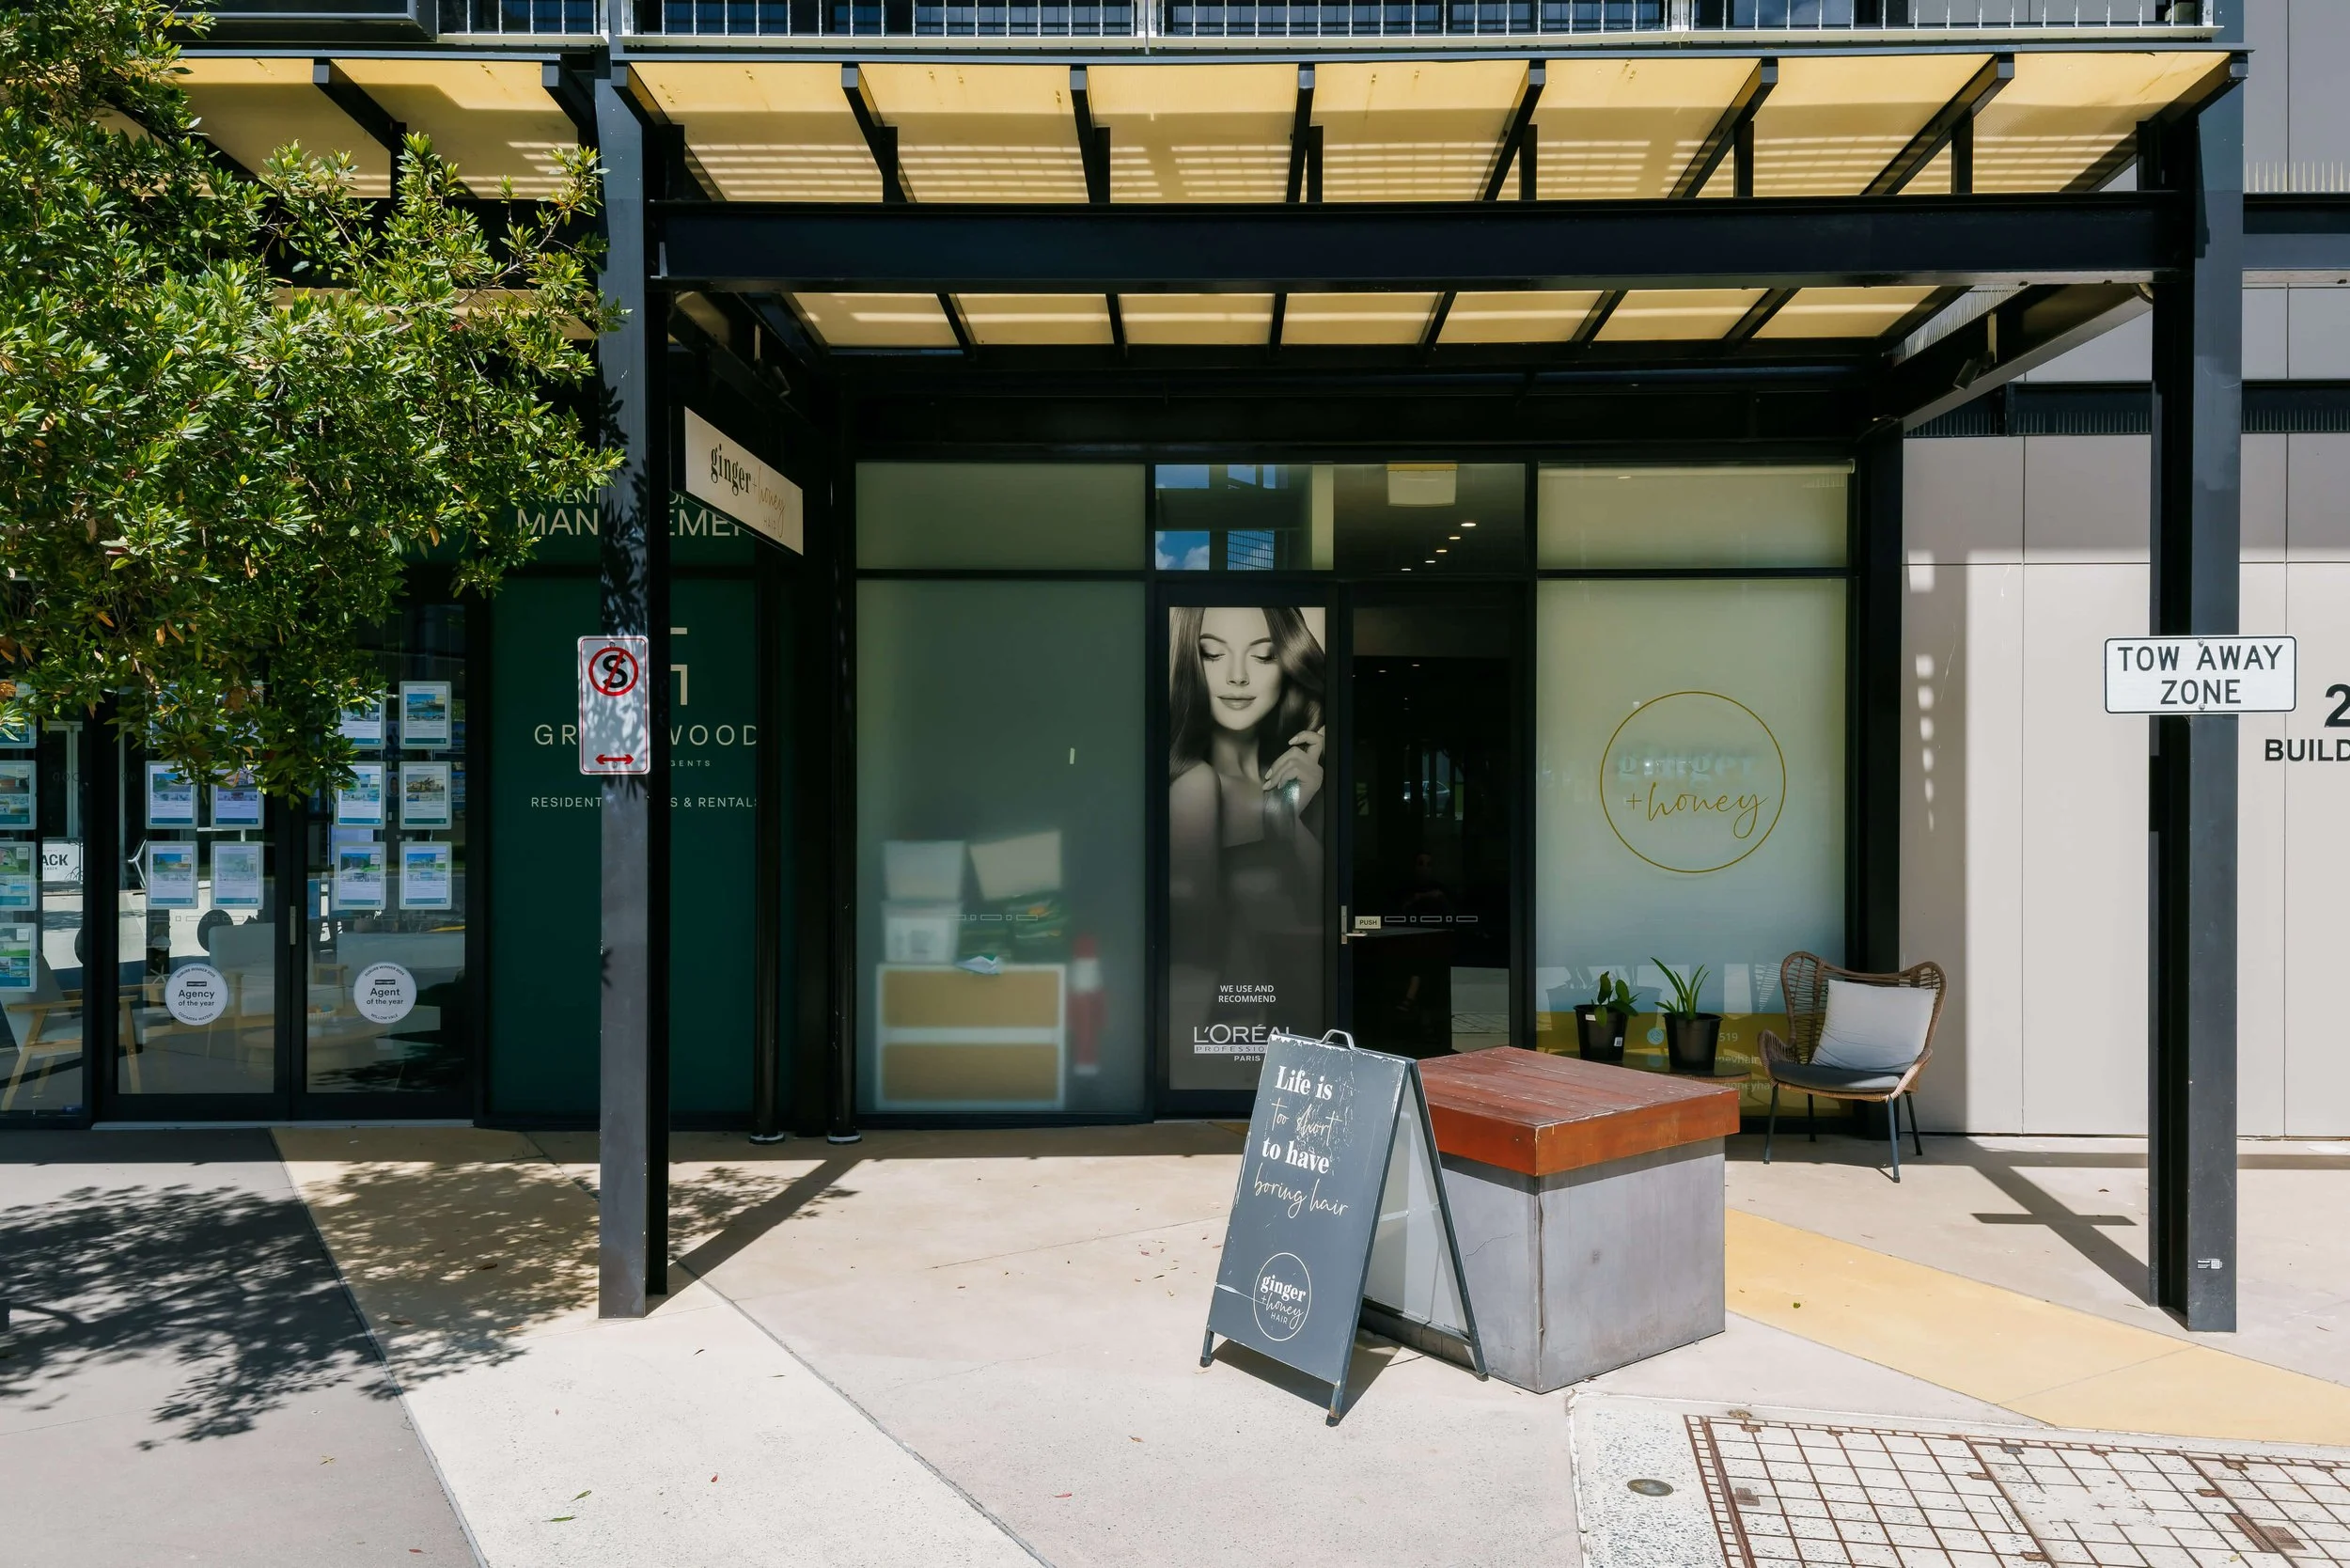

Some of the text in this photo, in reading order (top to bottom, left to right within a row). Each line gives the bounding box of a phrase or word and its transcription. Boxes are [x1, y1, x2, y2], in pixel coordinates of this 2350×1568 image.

[2117, 644, 2283, 671] TOW AWAY
[2160, 679, 2242, 705] ZONE
[531, 796, 602, 808] RESIDENT
[683, 796, 693, 808] &
[697, 796, 758, 808] RENTAL
[179, 989, 215, 1000] Agency
[369, 987, 400, 998] Agent
[1276, 1065, 1334, 1101] Life is
[1271, 1097, 1289, 1131] too
[1261, 1137, 1330, 1174] to have
[1254, 1162, 1349, 1219] boring hair
[1261, 1275, 1307, 1302] ginger
[1271, 1311, 1288, 1325] HAIR
